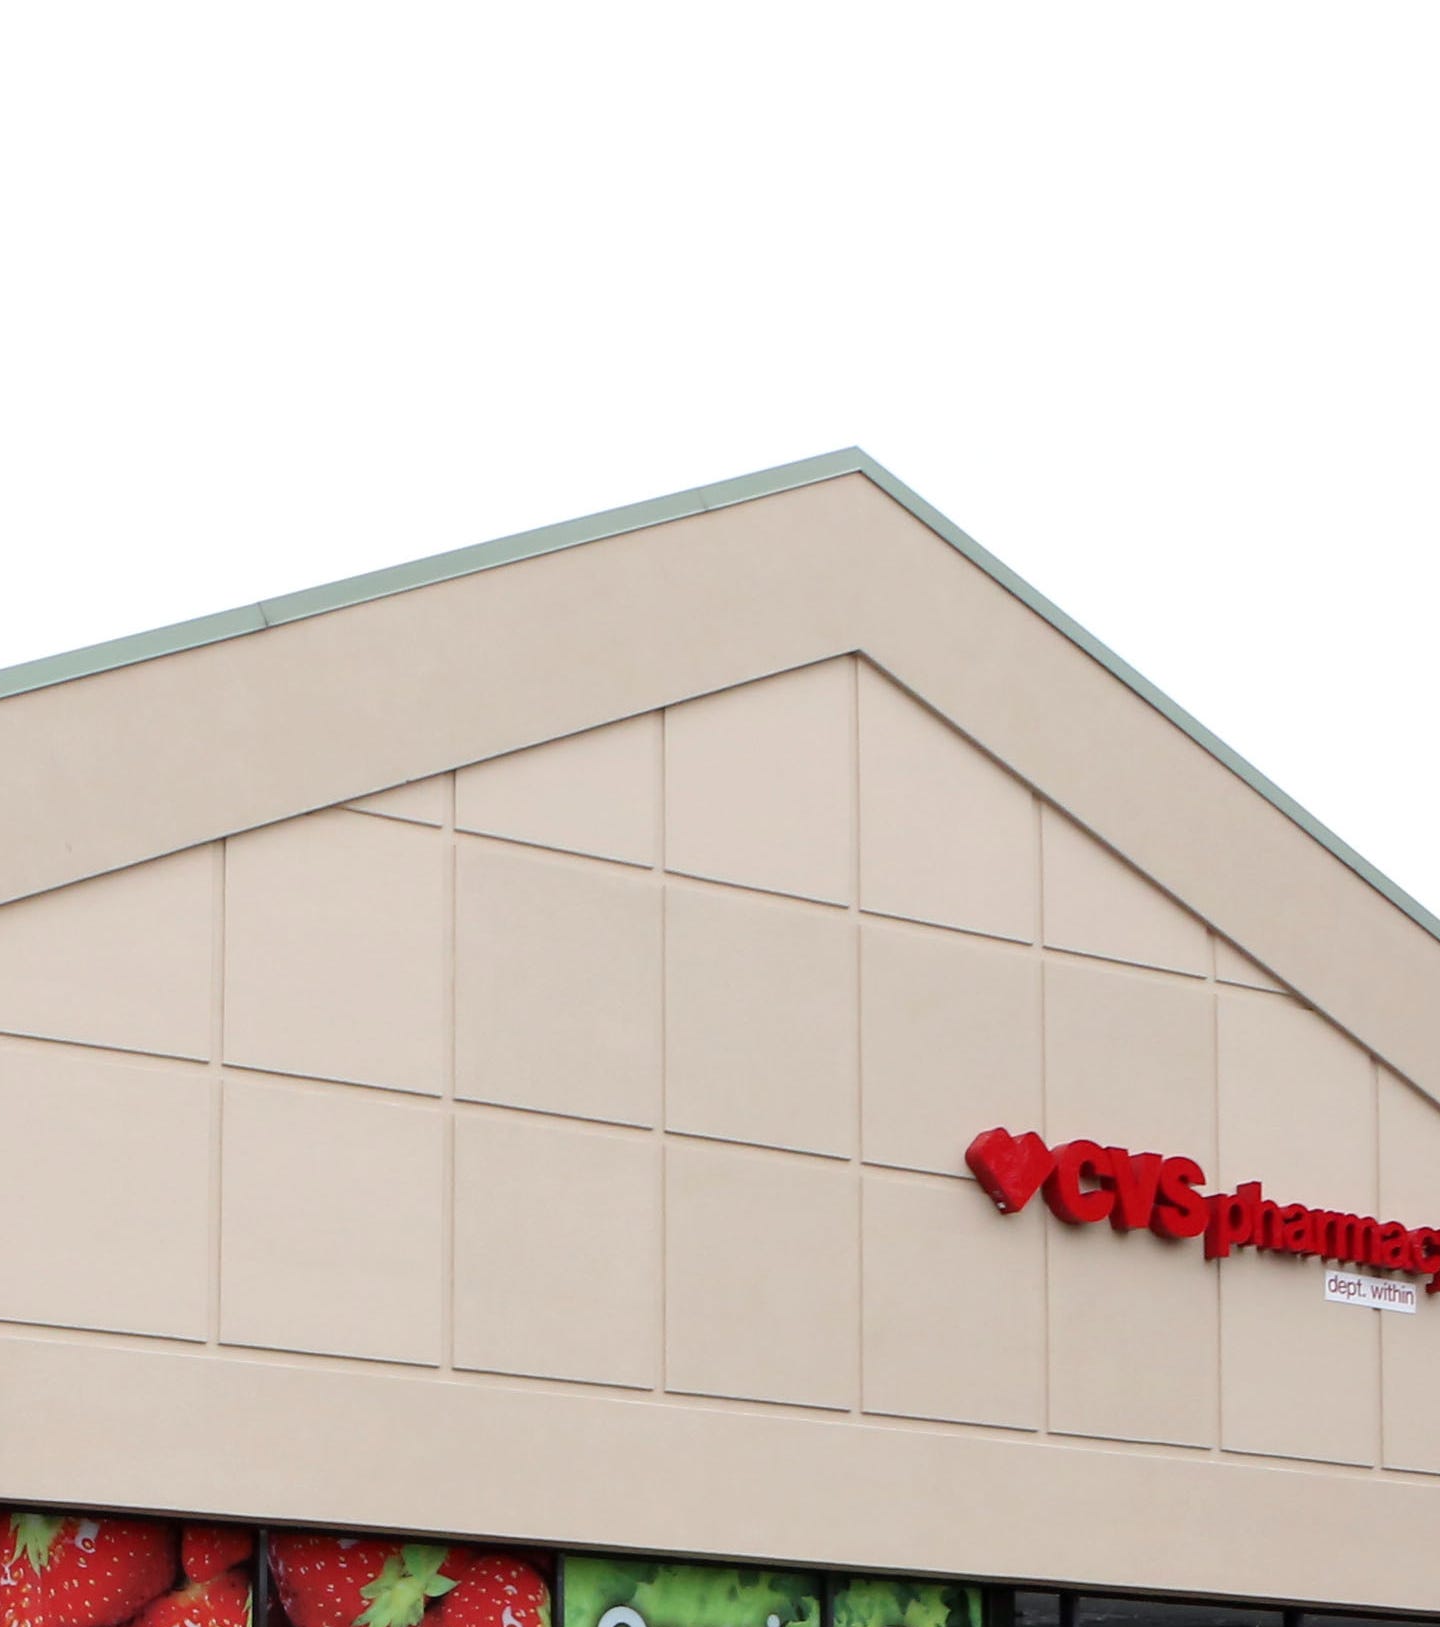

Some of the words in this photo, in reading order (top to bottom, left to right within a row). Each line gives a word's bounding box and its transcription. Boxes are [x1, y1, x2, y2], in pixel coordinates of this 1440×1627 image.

[1043, 1140, 1208, 1239] CVS
[1328, 1275, 1366, 1299] dept.
[1370, 1282, 1414, 1305] within
